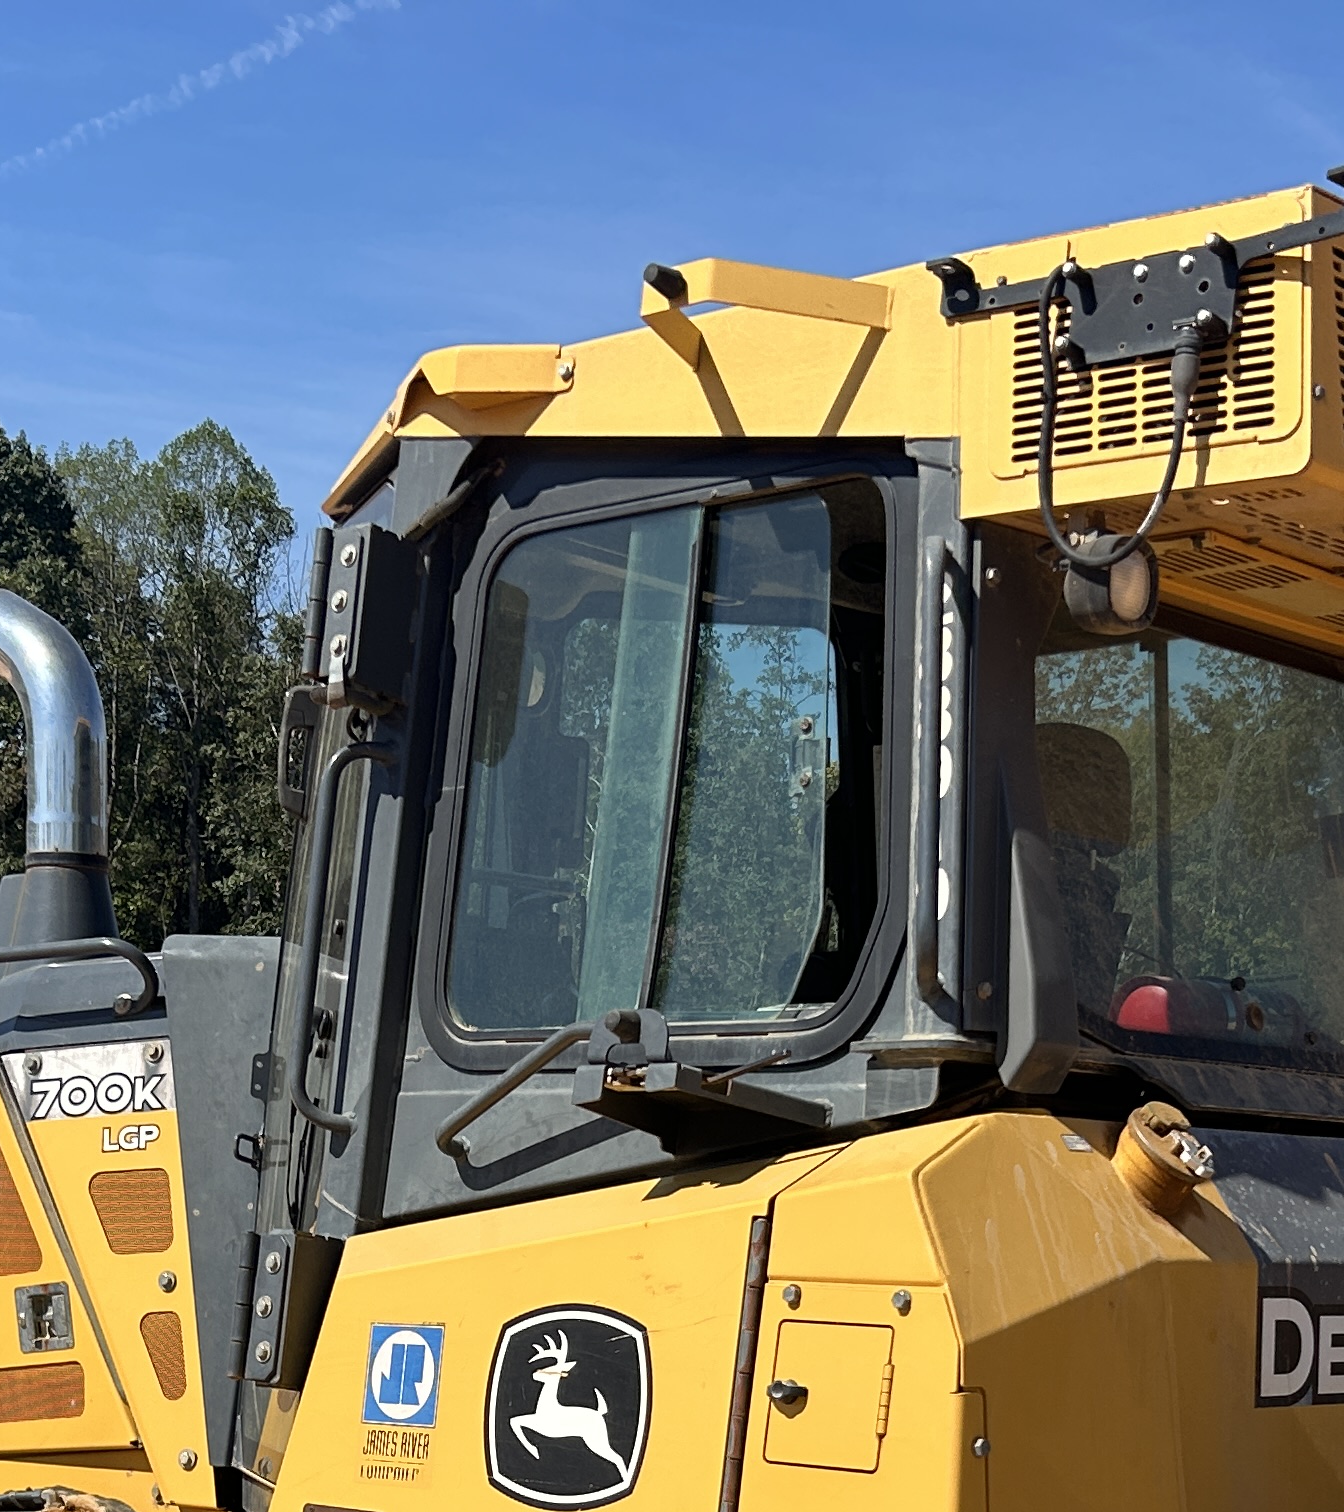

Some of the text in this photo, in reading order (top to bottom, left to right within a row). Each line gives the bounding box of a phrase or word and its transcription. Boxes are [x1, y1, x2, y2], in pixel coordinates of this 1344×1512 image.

[30, 1072, 168, 1121] 700K
[102, 1123, 161, 1153] LGP
[362, 1429, 431, 1461] JAMES RIVER
